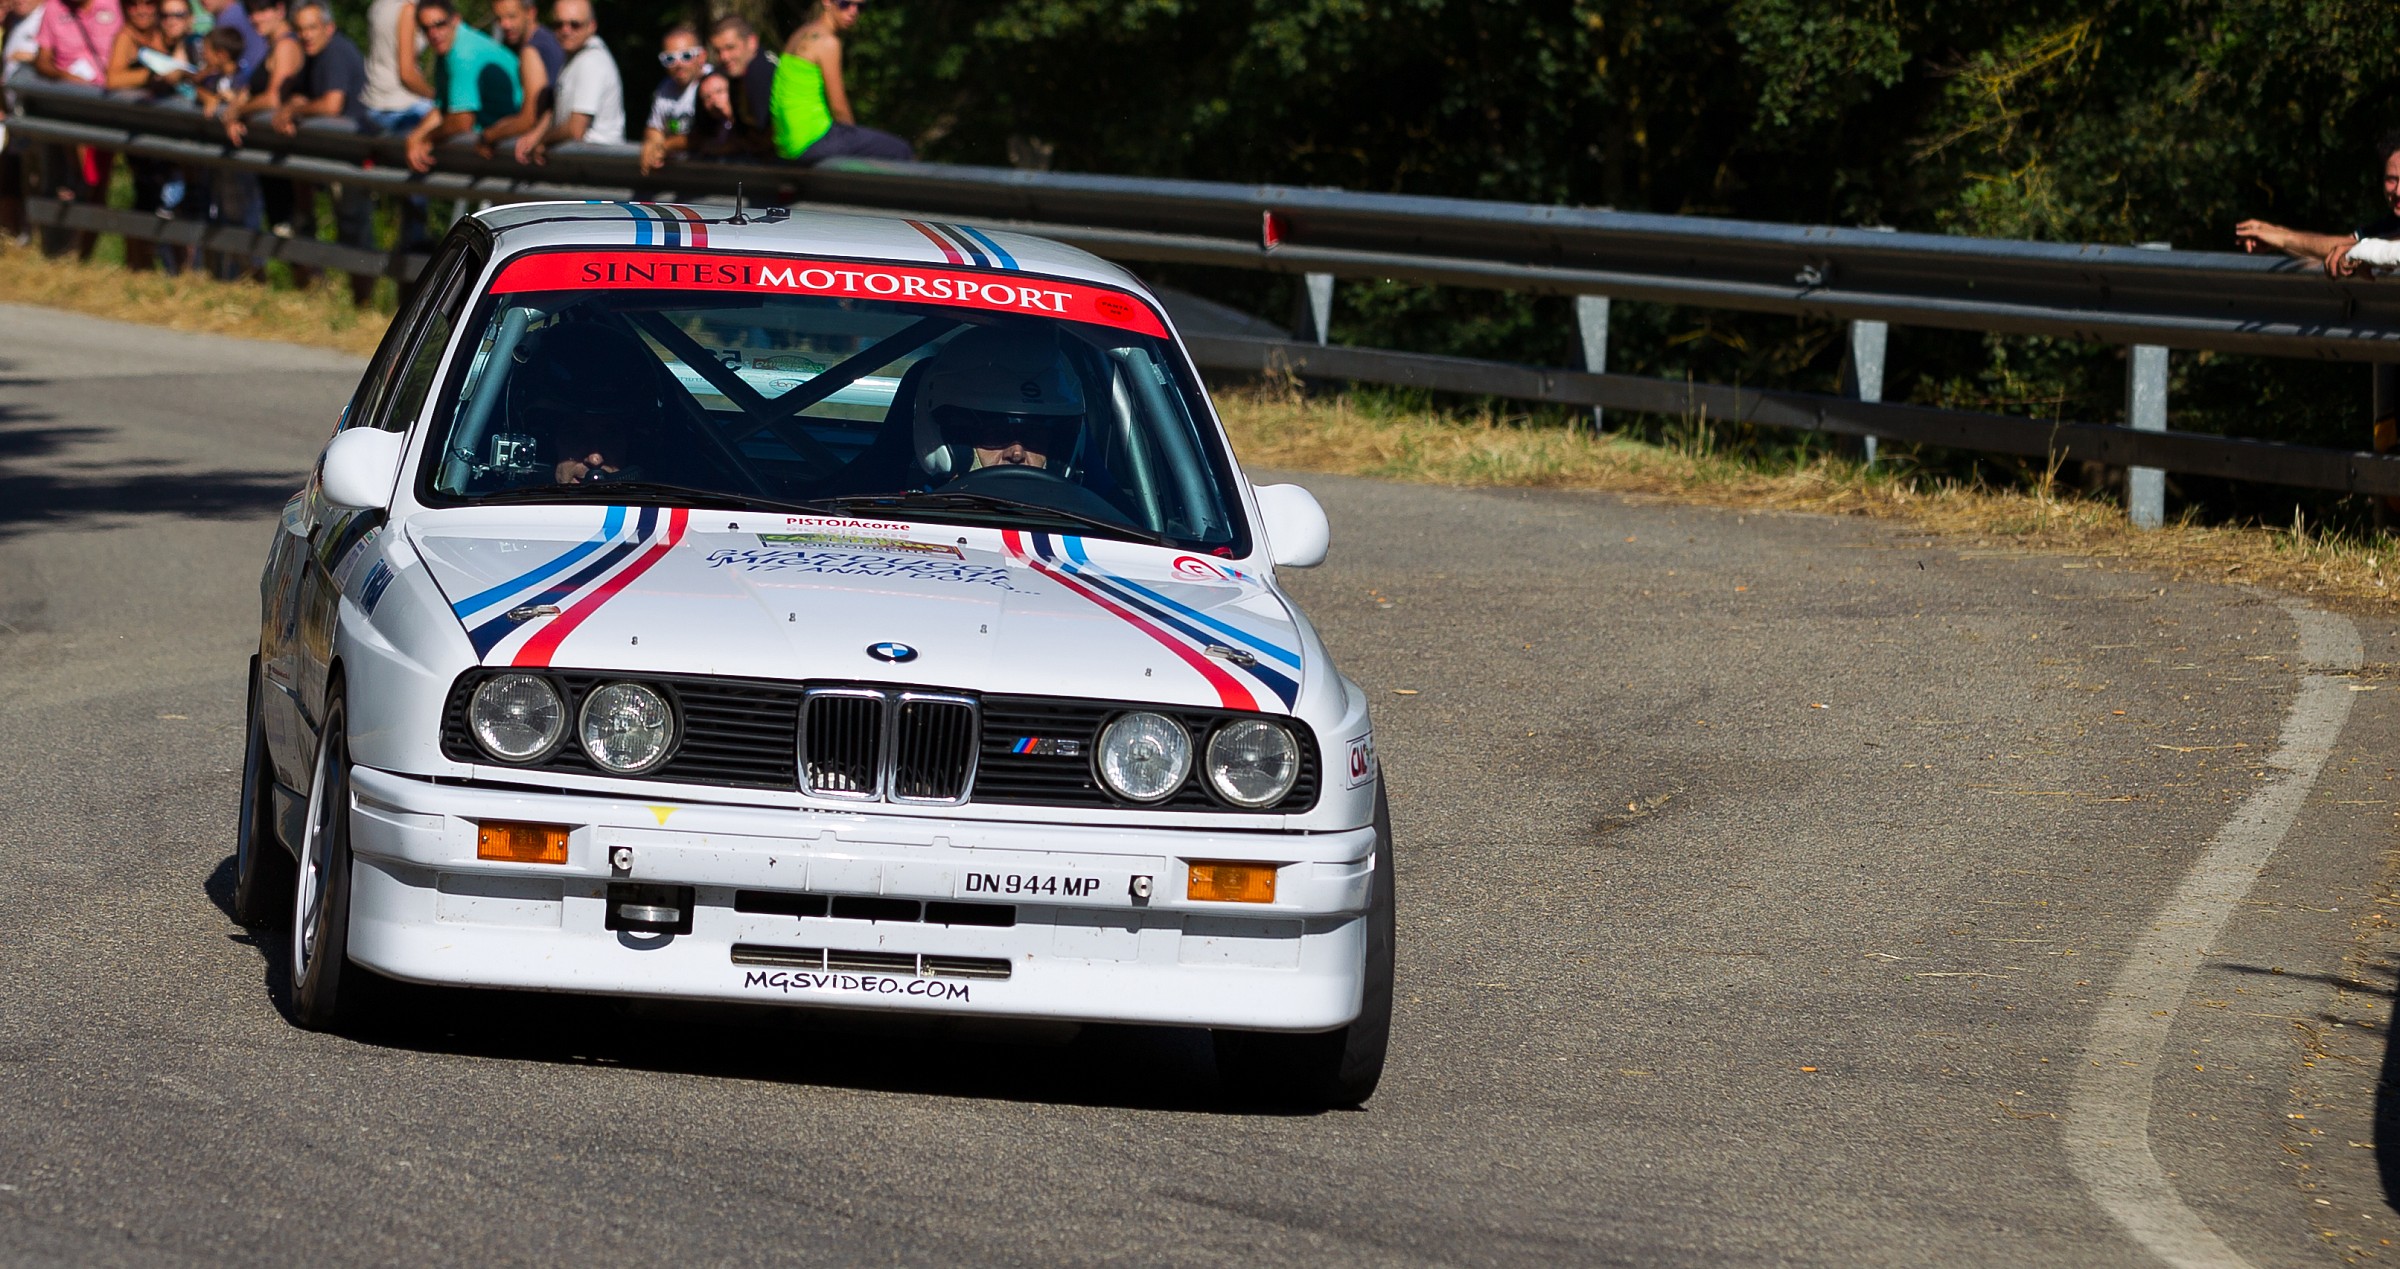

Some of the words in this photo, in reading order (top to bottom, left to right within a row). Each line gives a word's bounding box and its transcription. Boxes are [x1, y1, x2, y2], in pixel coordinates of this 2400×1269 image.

[786, 517, 910, 531] PISTOIAcorse
[706, 549, 1009, 574] GUARDUCCI
[797, 567, 897, 576] ANNI
[965, 872, 1001, 894] DN
[1005, 874, 1058, 896] 944
[1062, 877, 1101, 897] MP
[744, 971, 970, 1002] MGSVIDEO.COM
